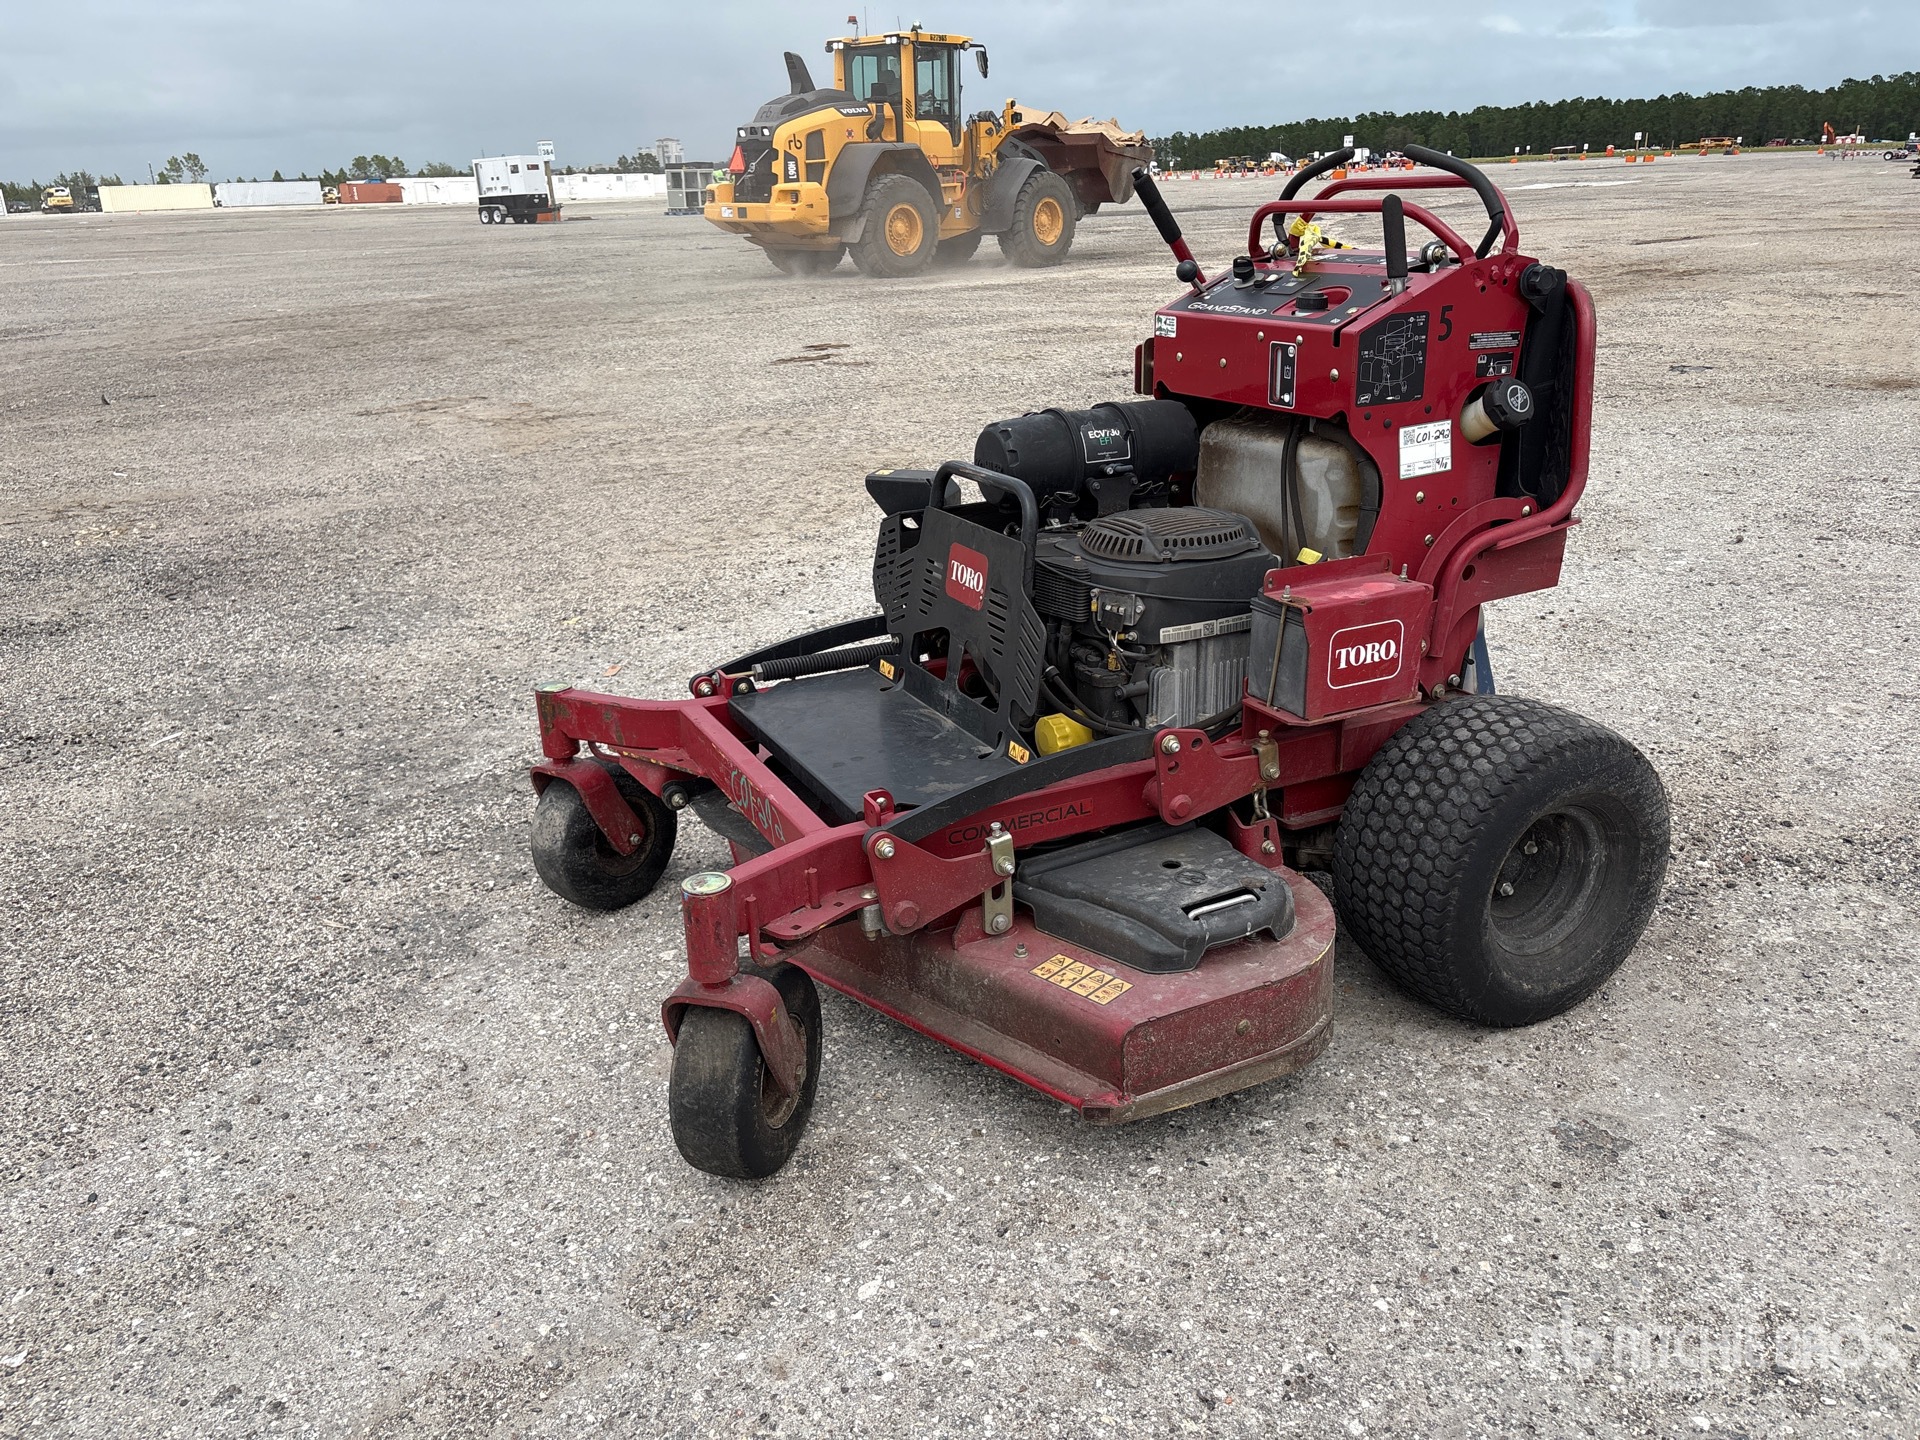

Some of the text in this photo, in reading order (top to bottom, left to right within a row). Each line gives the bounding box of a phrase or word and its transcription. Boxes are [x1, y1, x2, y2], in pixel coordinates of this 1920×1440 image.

[788, 133, 803, 150] rb
[787, 160, 798, 179] L90H
[1437, 304, 1454, 341] 5
[1099, 436, 1113, 446] EFI
[1416, 428, 1451, 444] C01-292
[950, 559, 984, 592] TORO
[1335, 639, 1397, 670] TORO
[948, 801, 1092, 845] COMMERCIAL
